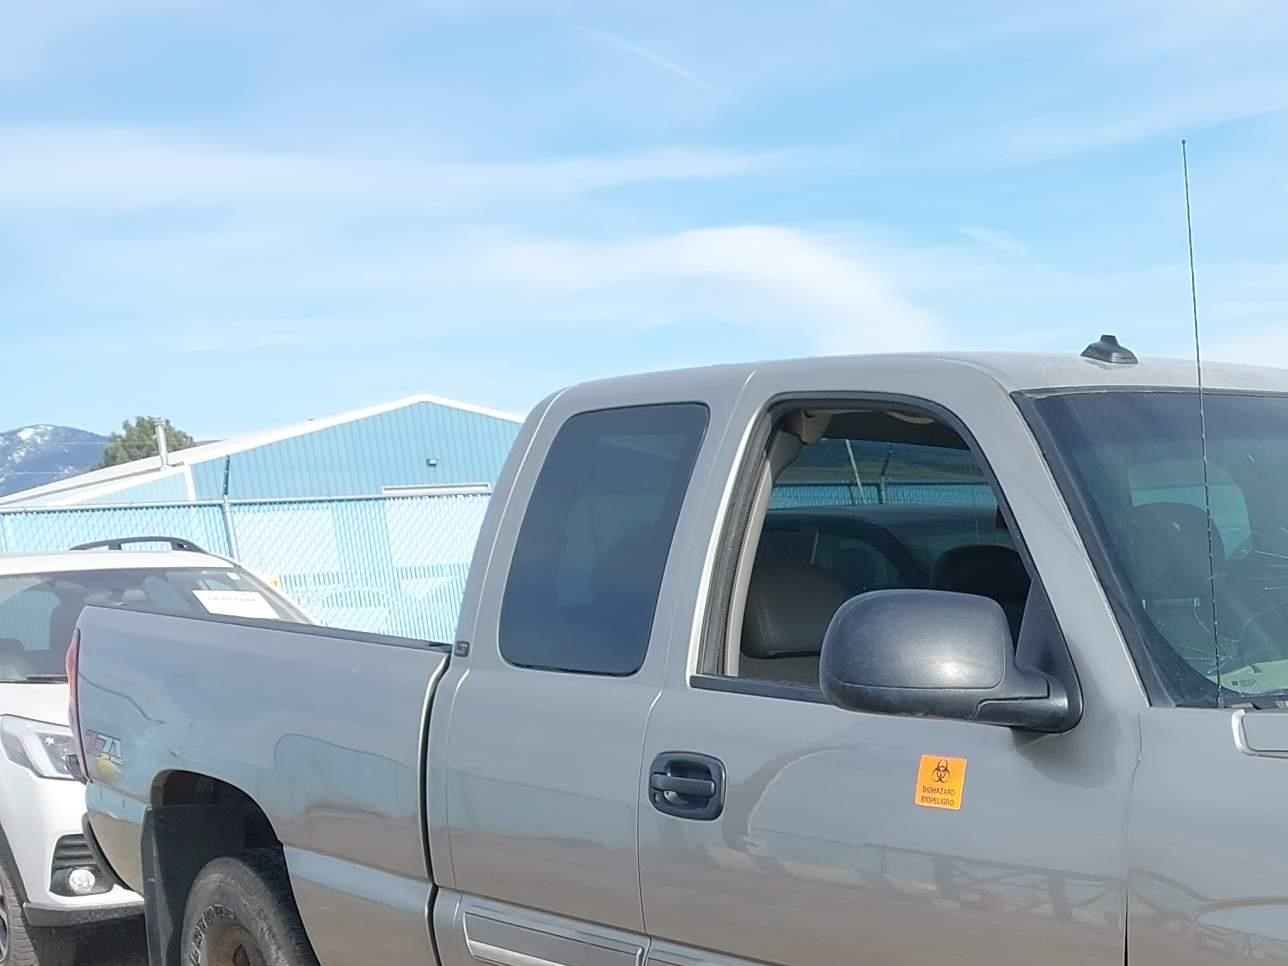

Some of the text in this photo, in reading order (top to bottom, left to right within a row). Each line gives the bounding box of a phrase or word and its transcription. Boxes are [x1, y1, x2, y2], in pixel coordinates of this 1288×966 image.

[86, 728, 122, 759] Z71
[922, 785, 956, 796] BIOHAZARD
[921, 796, 955, 807] BIOPELIGRO
